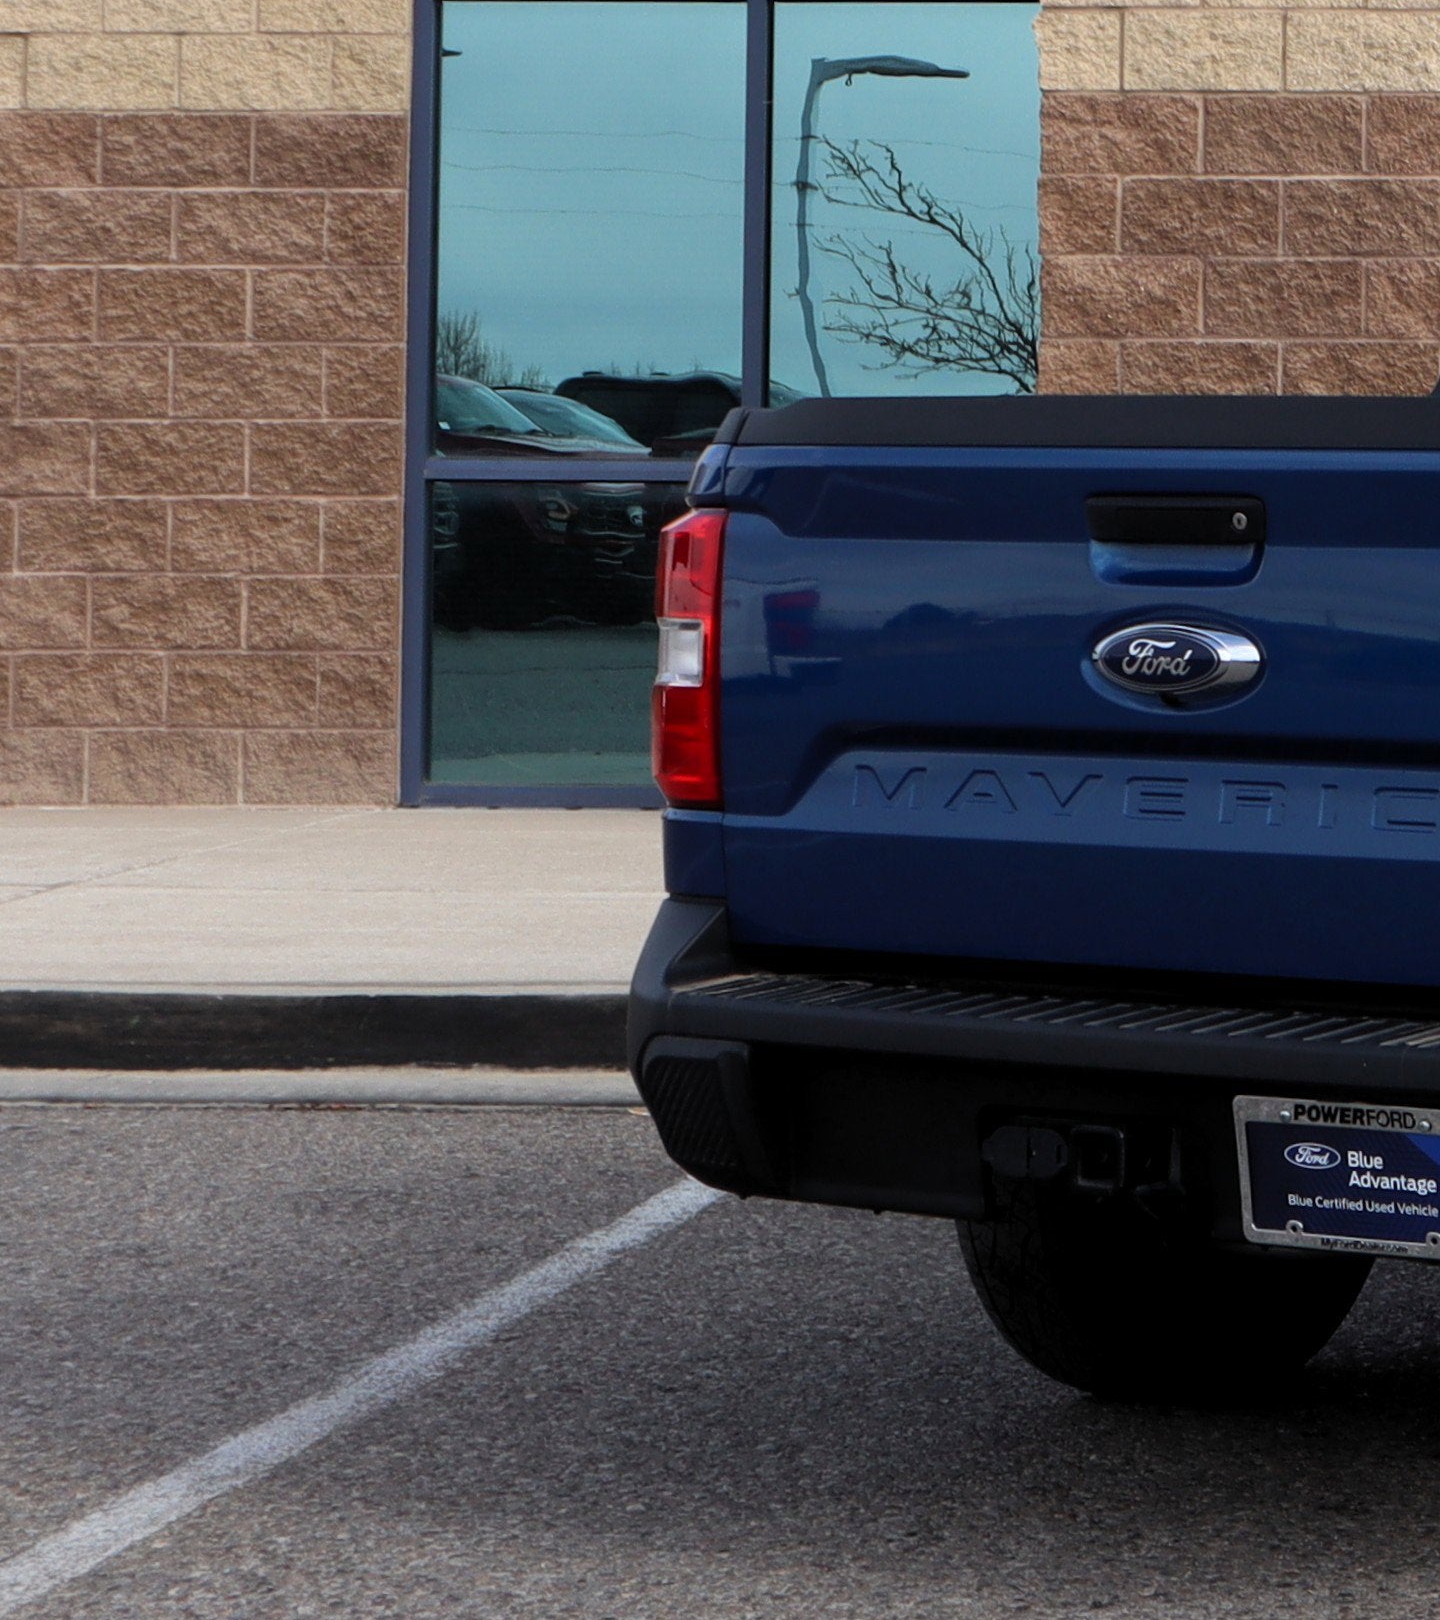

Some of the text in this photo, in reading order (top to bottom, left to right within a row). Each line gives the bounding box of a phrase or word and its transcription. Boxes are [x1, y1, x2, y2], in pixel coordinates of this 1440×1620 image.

[1121, 638, 1192, 678] Ford
[1293, 1103, 1416, 1130] POWERFORD
[1295, 1143, 1331, 1166] Ford
[1347, 1150, 1384, 1170] Blue
[1348, 1171, 1438, 1196] Advantage
[1287, 1193, 1440, 1218] Blue Certified Used Vehicle
